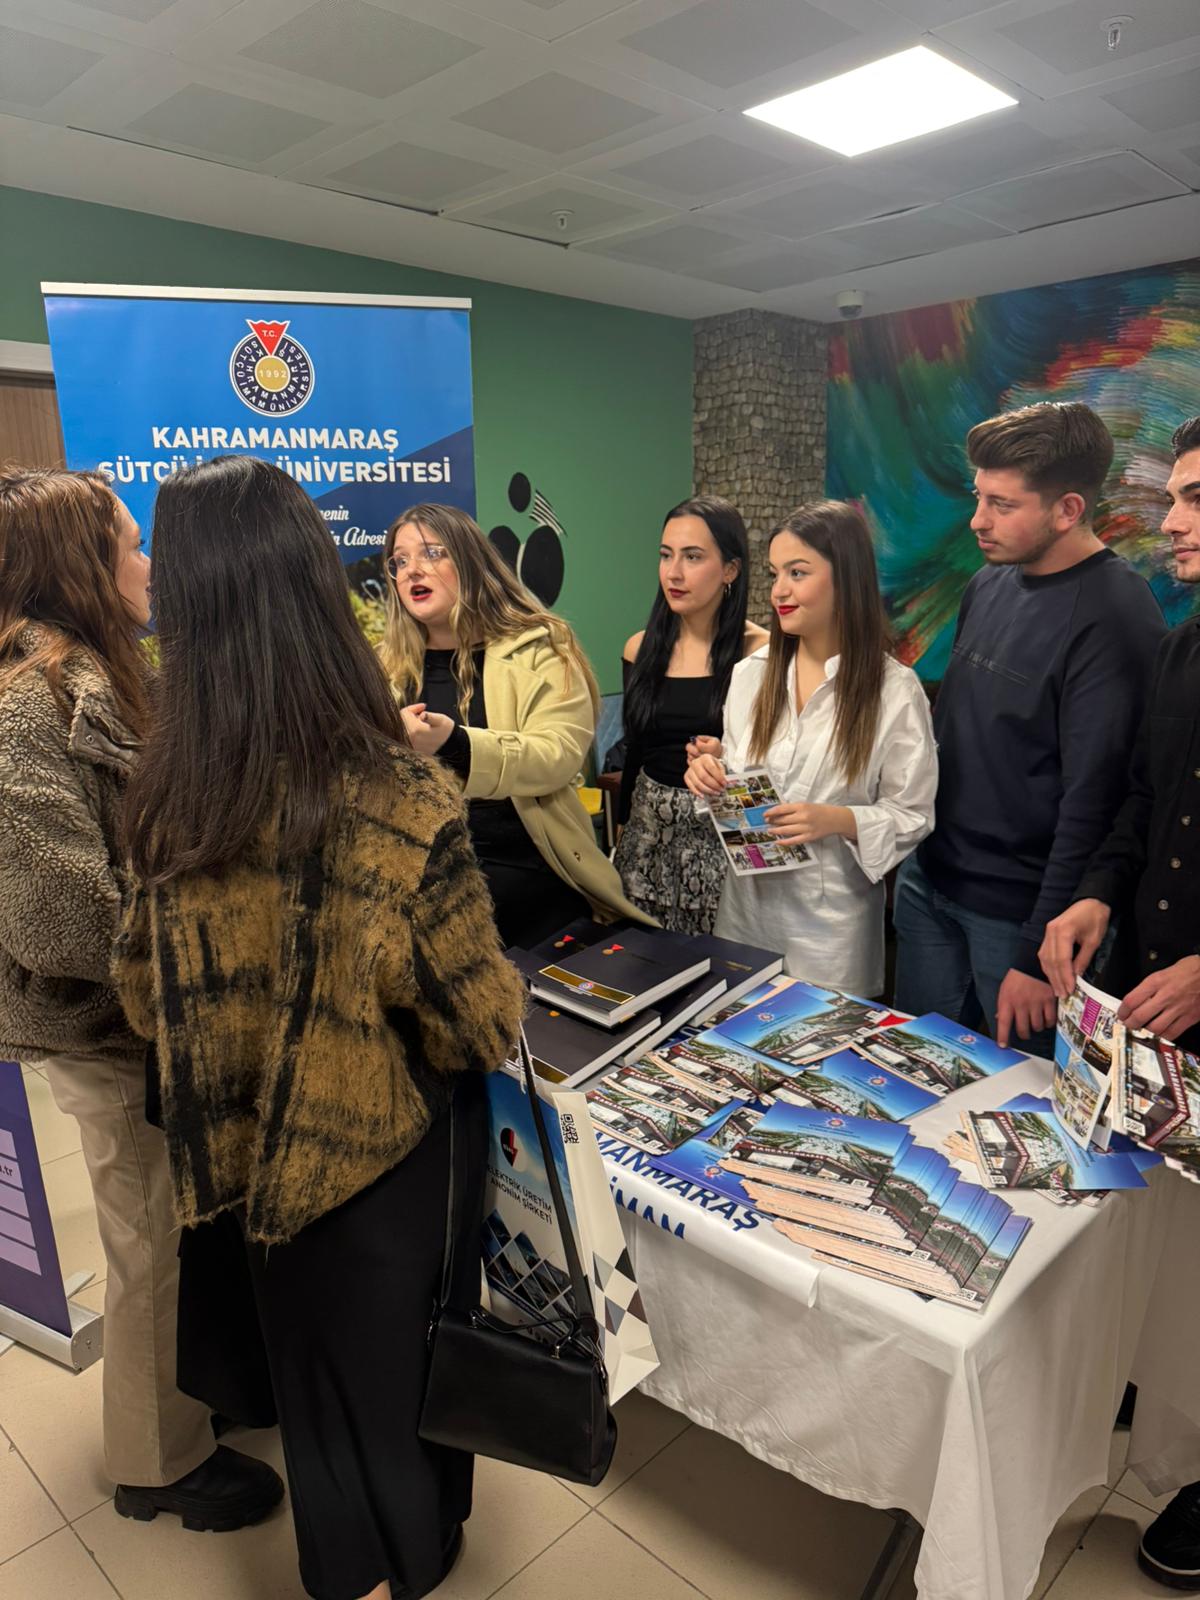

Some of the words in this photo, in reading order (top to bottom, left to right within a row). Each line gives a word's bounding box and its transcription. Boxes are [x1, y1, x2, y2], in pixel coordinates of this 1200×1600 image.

[261, 330, 278, 338] T.C.
[259, 369, 287, 378] 1992
[151, 426, 400, 453] KAHRAMANMARAŞ
[276, 455, 451, 483] ÜNİVERSİTESİ
[320, 505, 350, 521] enin
[343, 526, 388, 546] Adresi
